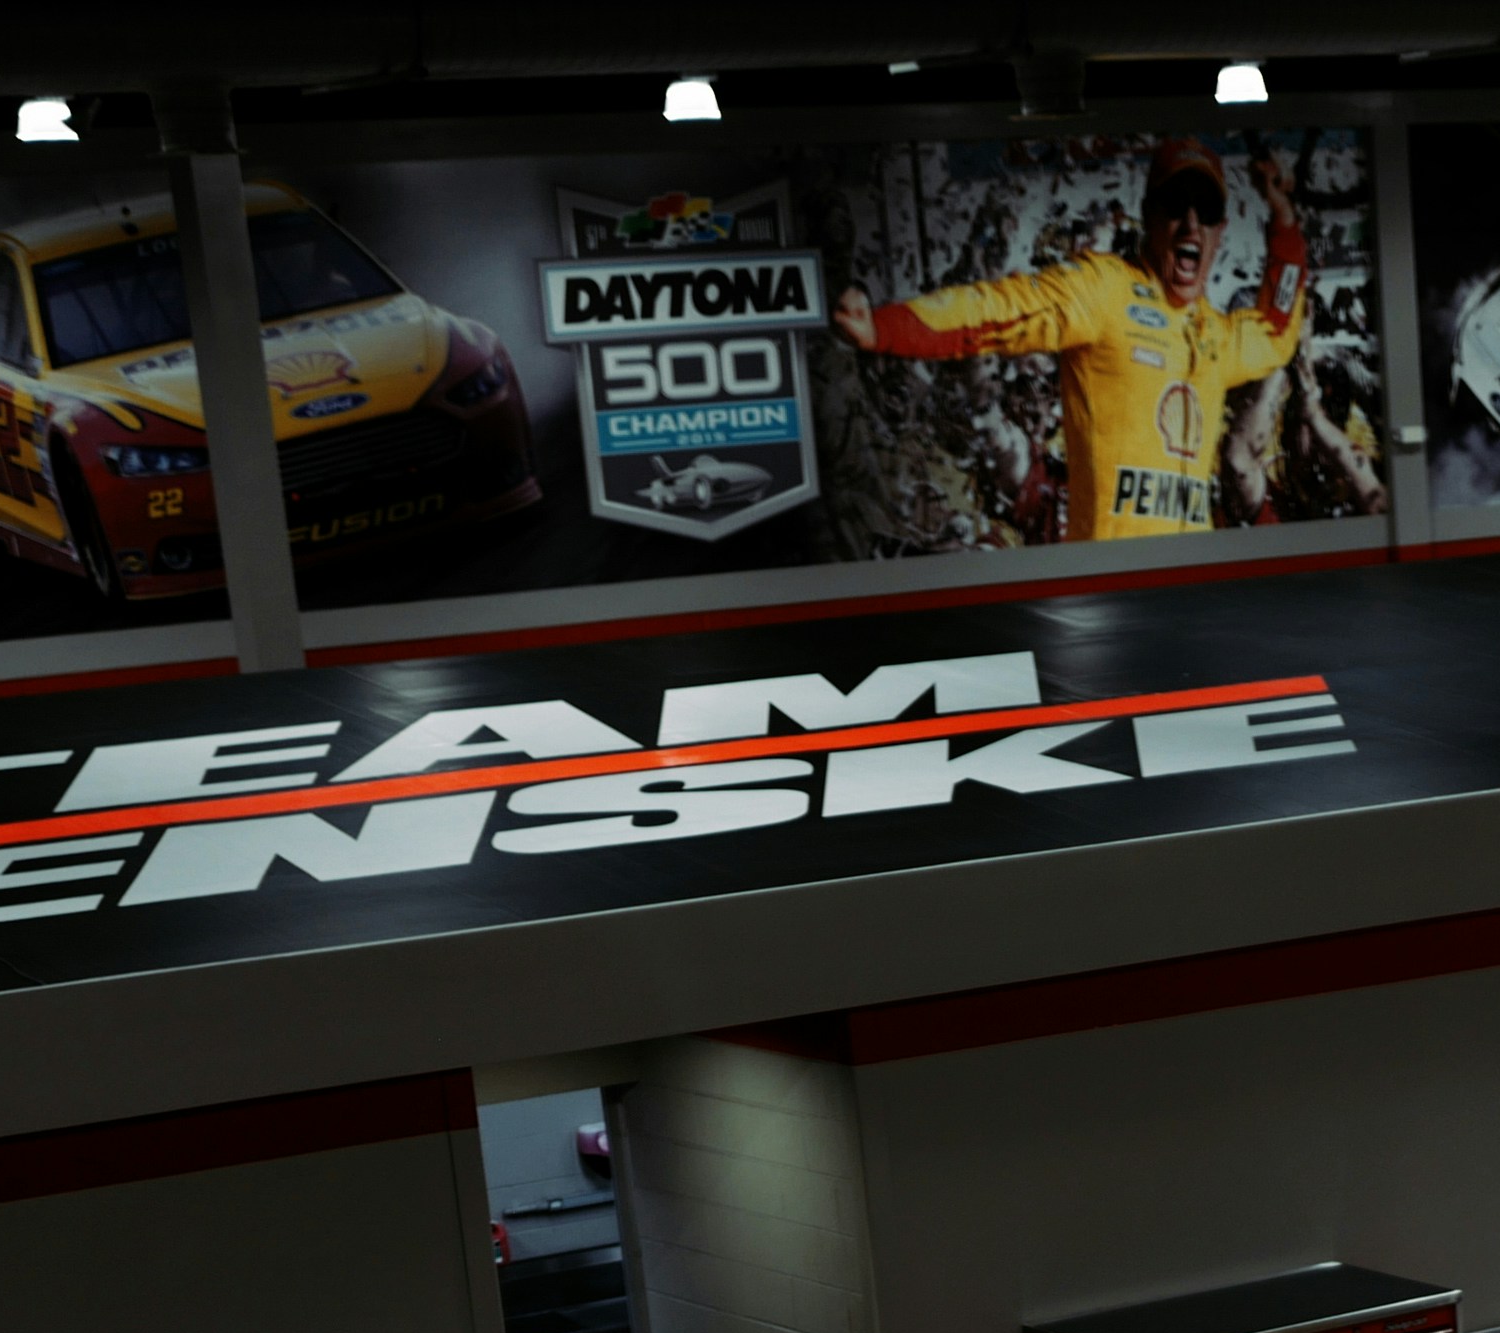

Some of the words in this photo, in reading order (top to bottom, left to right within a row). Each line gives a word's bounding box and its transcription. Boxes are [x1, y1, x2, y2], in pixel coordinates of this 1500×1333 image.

[564, 266, 809, 324] DAYTONA
[602, 337, 783, 405] 500
[607, 404, 789, 438] CHAMPION
[148, 488, 183, 518] 22
